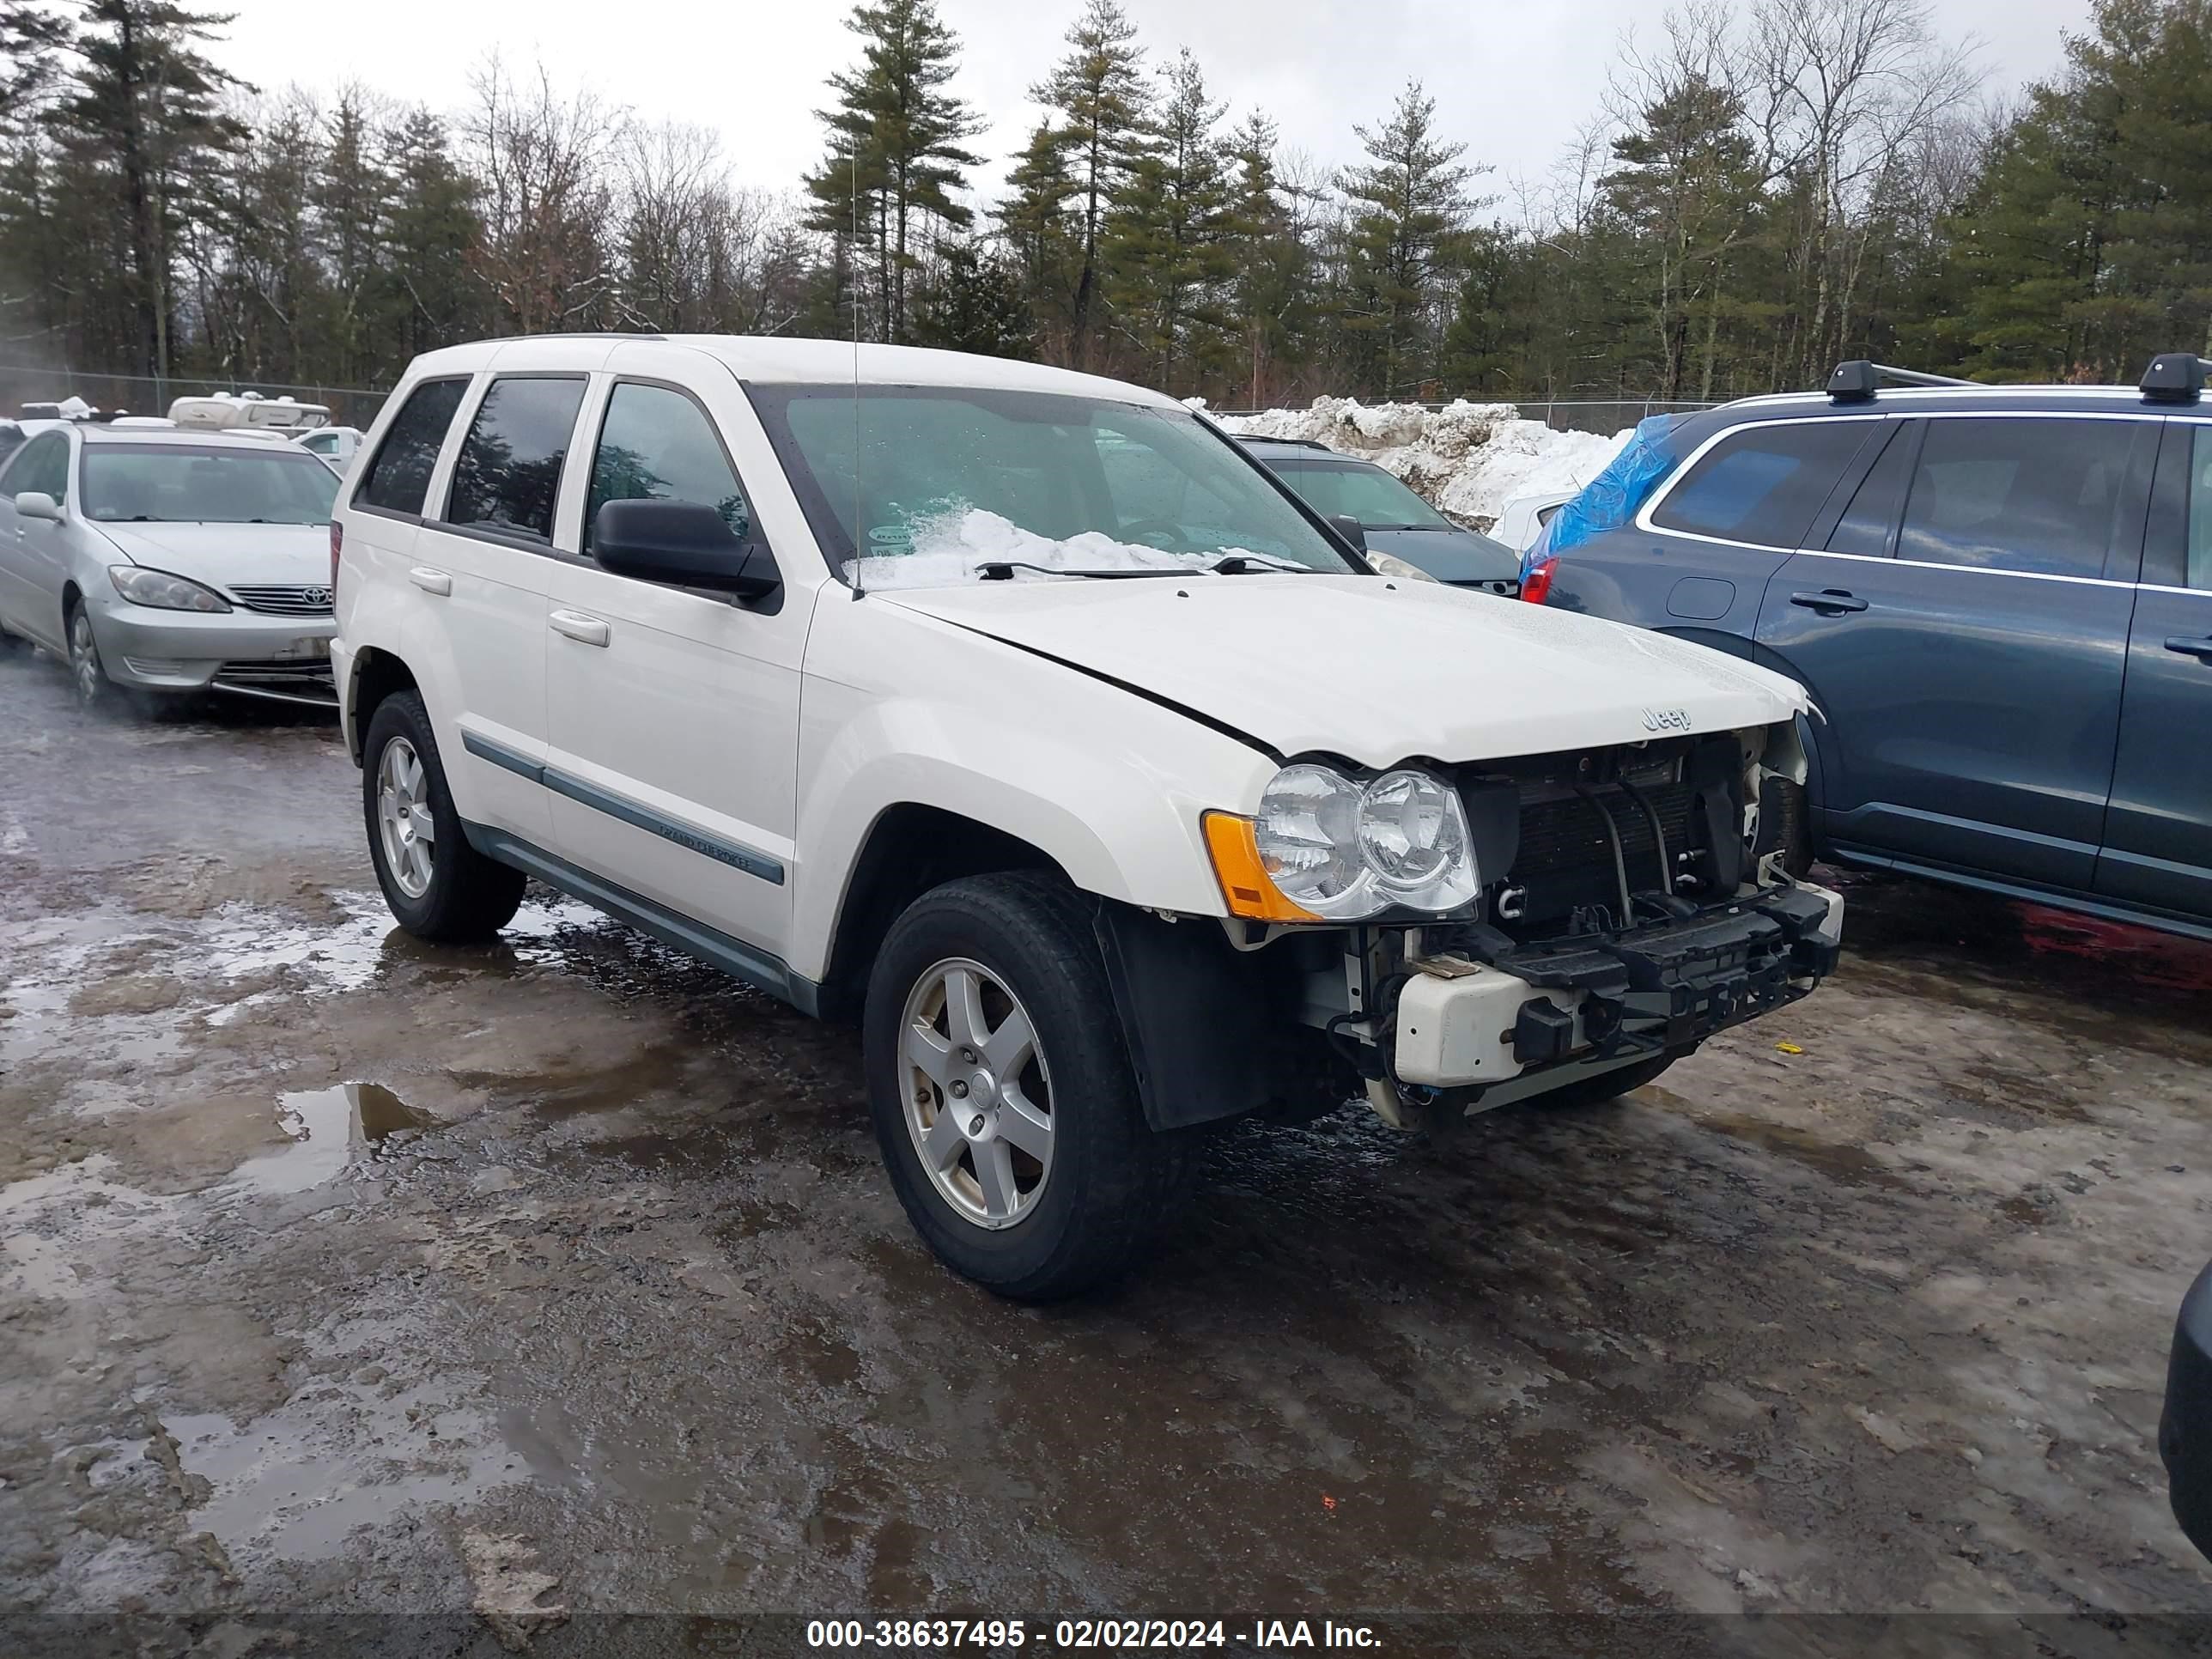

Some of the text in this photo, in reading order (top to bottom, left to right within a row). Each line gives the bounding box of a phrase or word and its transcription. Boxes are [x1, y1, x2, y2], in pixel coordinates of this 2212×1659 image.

[1641, 708, 1692, 731] Jeep
[659, 824, 751, 868] GRAND CHEROKEE
